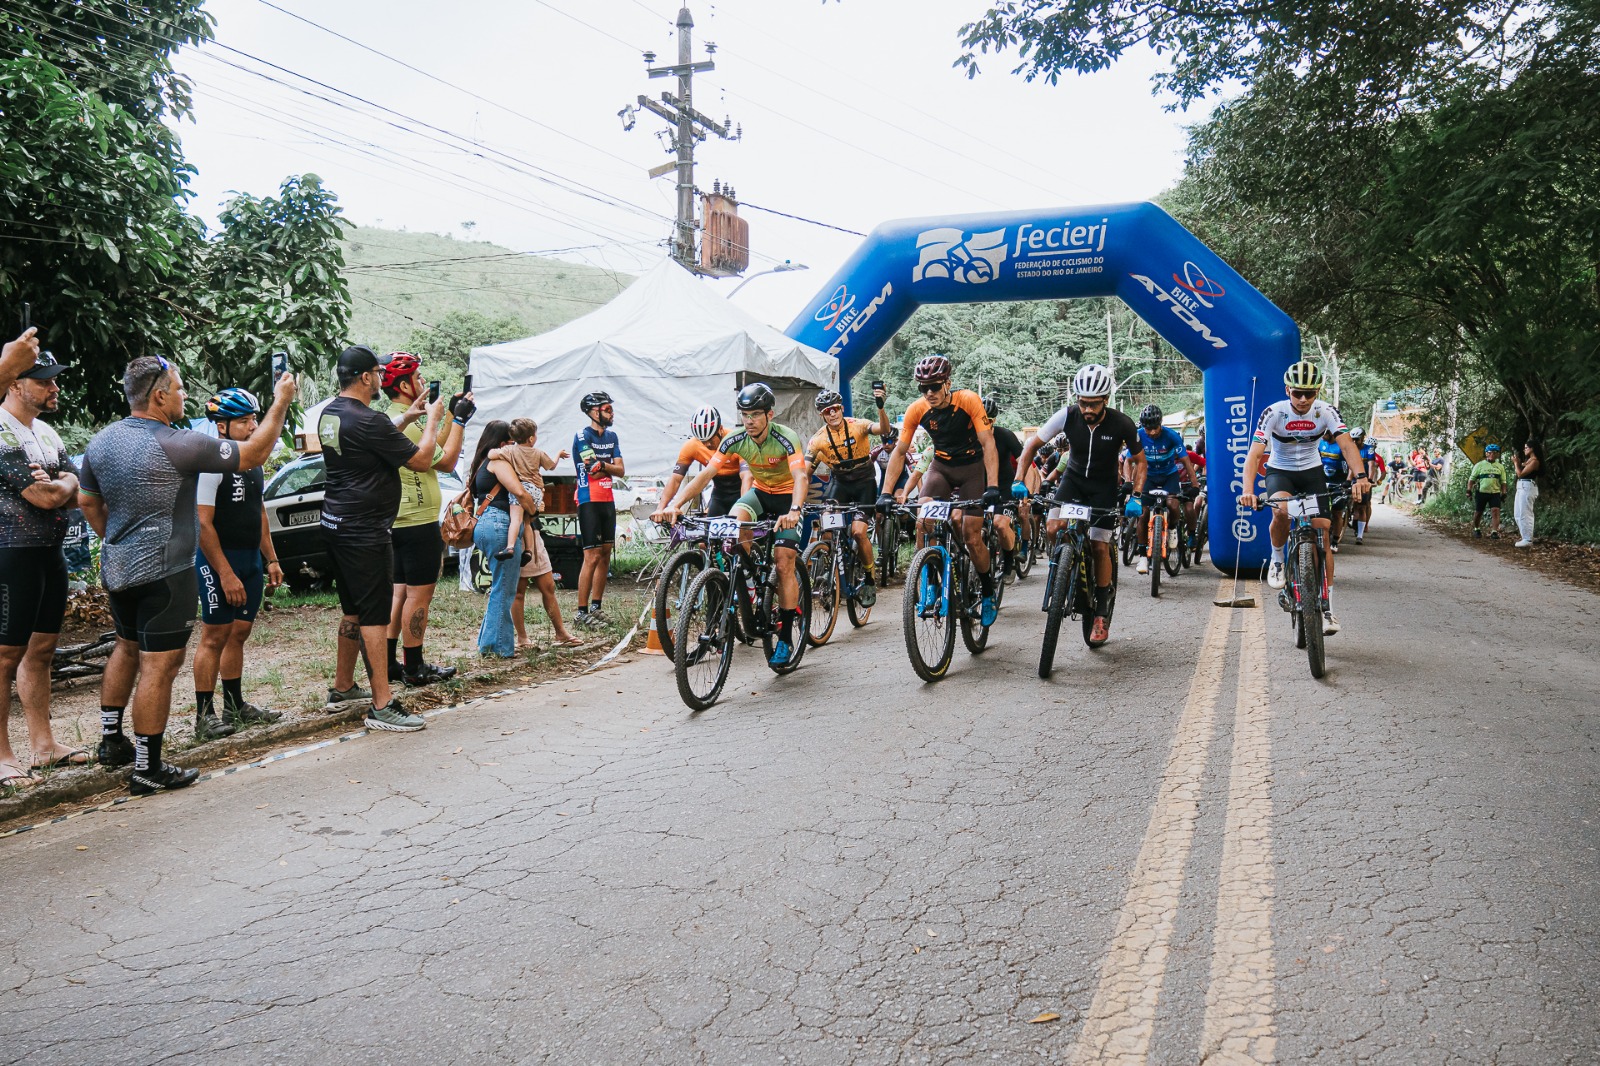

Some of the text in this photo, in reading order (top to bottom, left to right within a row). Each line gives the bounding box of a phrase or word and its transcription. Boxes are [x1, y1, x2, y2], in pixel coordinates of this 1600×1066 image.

[1012, 218, 1108, 257] fecierj
[1015, 260, 1050, 270] FEDERAÇÃO
[1053, 260, 1061, 268] DE
[1062, 258, 1092, 267] CICLISMO
[1017, 266, 1103, 279] ESTADO DO RIO DE JANEIRO
[1170, 286, 1200, 313] BIKE
[1128, 272, 1228, 349] ATOM
[835, 306, 859, 333] BIKE
[923, 504, 948, 518] 124
[1067, 506, 1084, 516] 26
[1299, 501, 1306, 515] 1
[829, 515, 836, 525] 2
[711, 522, 738, 535] 322
[200, 565, 219, 614] BRASIL
